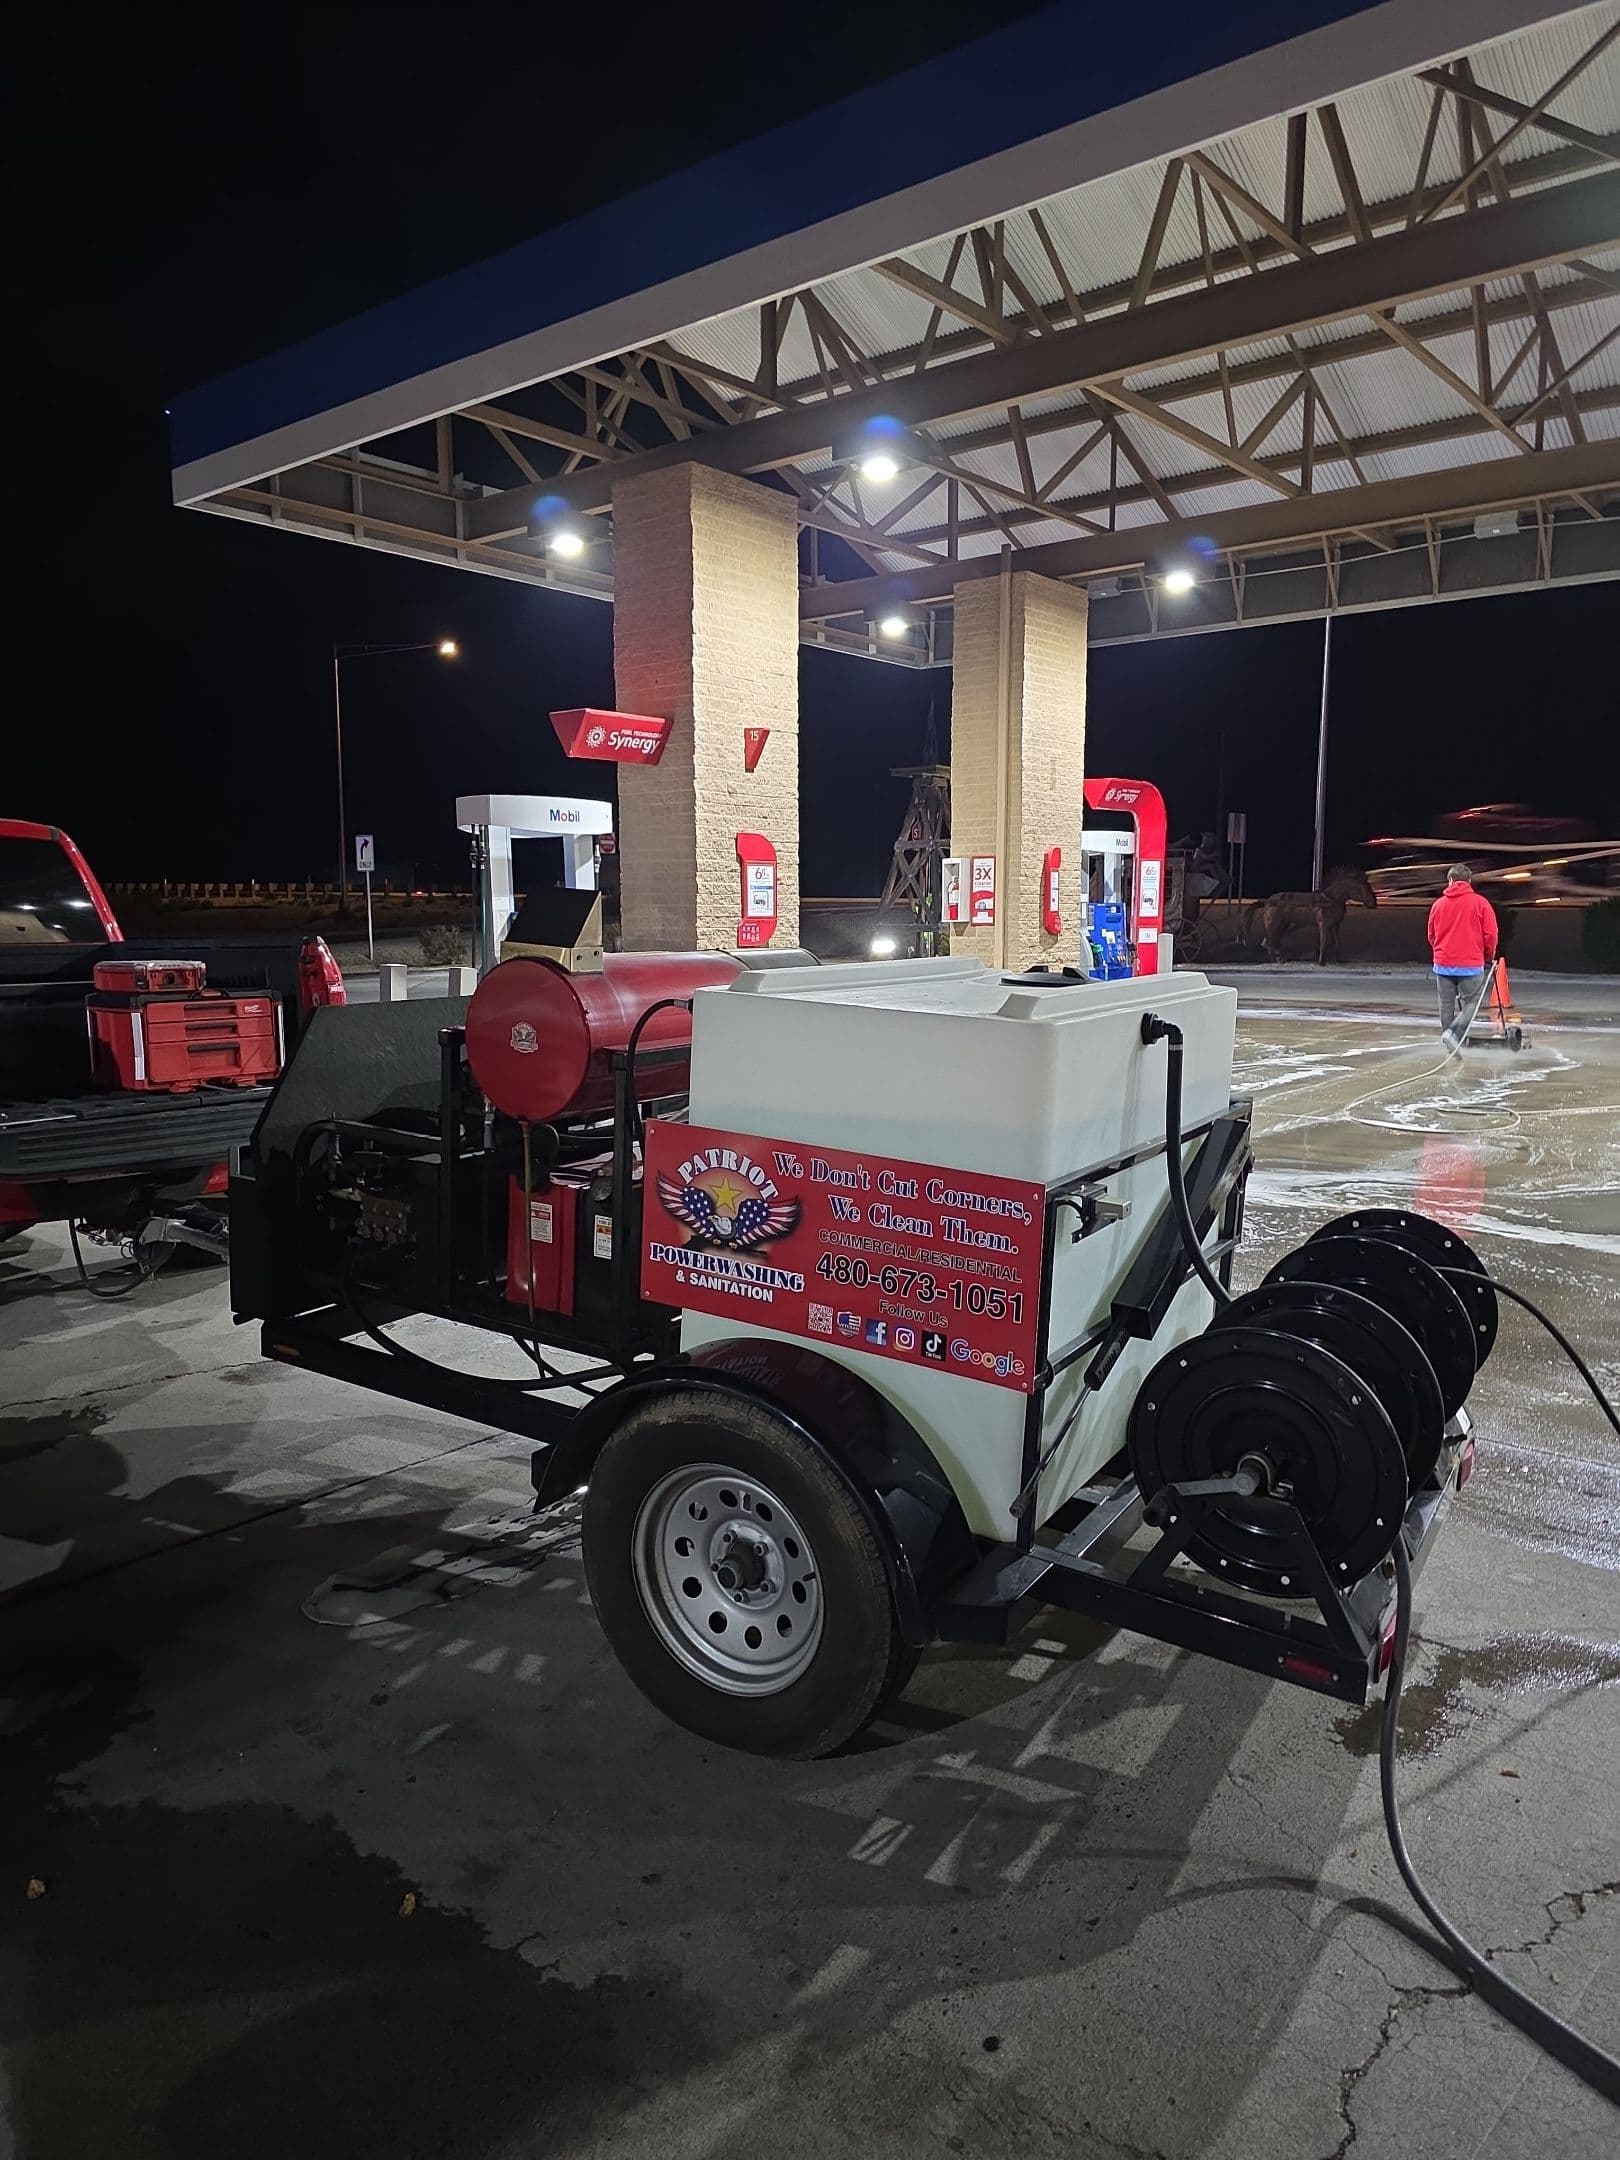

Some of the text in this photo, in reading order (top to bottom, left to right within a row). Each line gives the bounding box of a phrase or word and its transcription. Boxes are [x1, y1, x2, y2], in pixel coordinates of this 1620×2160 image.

[608, 731, 661, 754] Synergy
[749, 731, 759, 742] 15
[549, 808, 581, 823] Mobil
[975, 867, 993, 881] 3X
[676, 1148, 779, 1203] PATRIOT
[772, 1151, 1033, 1225] We Don't Cut Corners,
[828, 1194, 1019, 1254] We Clean Them.
[649, 1241, 805, 1293] POWERWASHING
[818, 1229, 1023, 1283] COMMERCIAL/RESIDENTIAL
[675, 1270, 774, 1303] & SANITATION
[815, 1251, 1024, 1324] 480-673-1051
[878, 1299, 949, 1328] Follow Us
[951, 1338, 1025, 1377] Google
